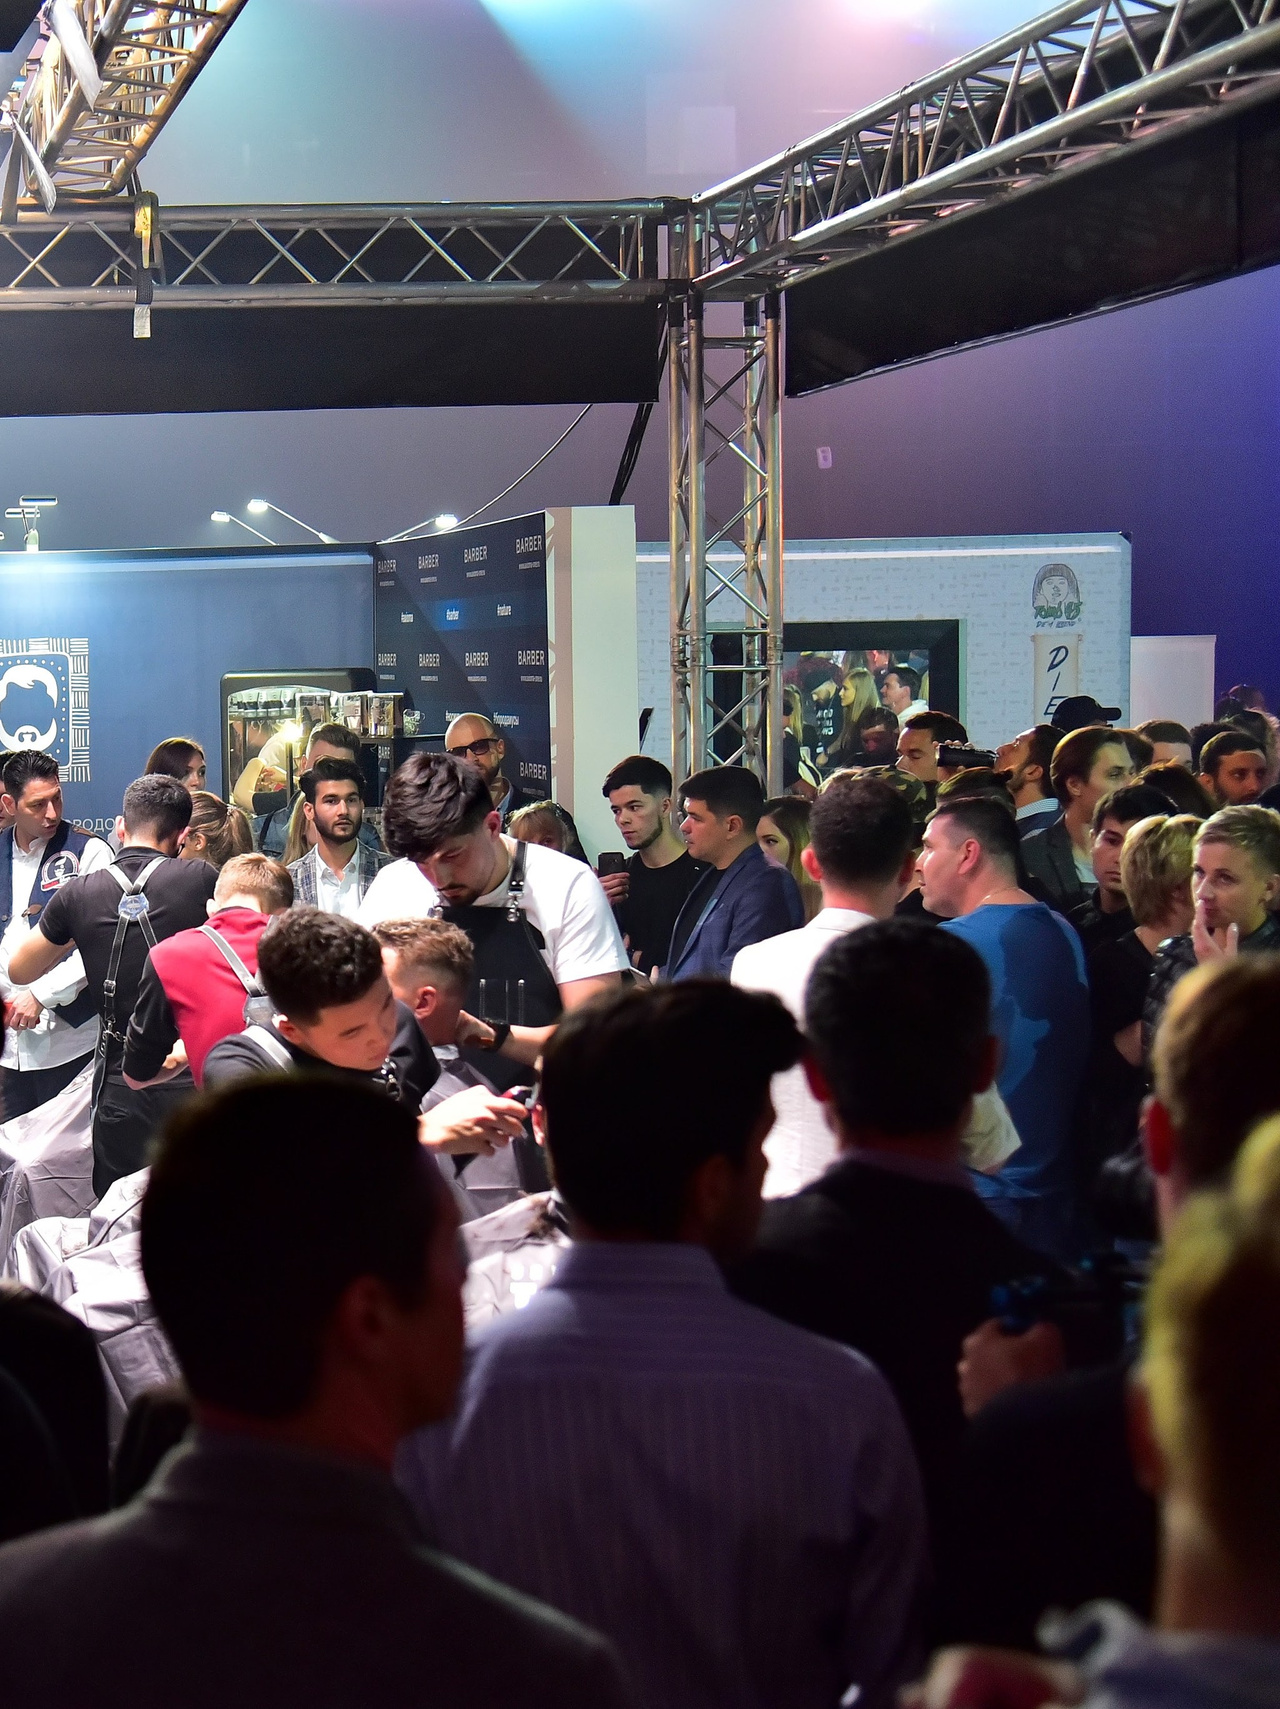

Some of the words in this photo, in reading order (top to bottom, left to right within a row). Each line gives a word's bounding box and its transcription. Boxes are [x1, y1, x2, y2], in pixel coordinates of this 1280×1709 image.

[516, 535, 542, 554] BARBER
[418, 554, 439, 569] BARBER
[464, 546, 487, 563] BARBER
[377, 560, 397, 573] BARBER
[378, 653, 397, 666] BARBER
[418, 653, 440, 667] BARBER
[465, 652, 489, 667] BARBER
[517, 650, 545, 665] BARBER
[520, 762, 547, 780] BARBER
[65, 818, 116, 833] РОДО
